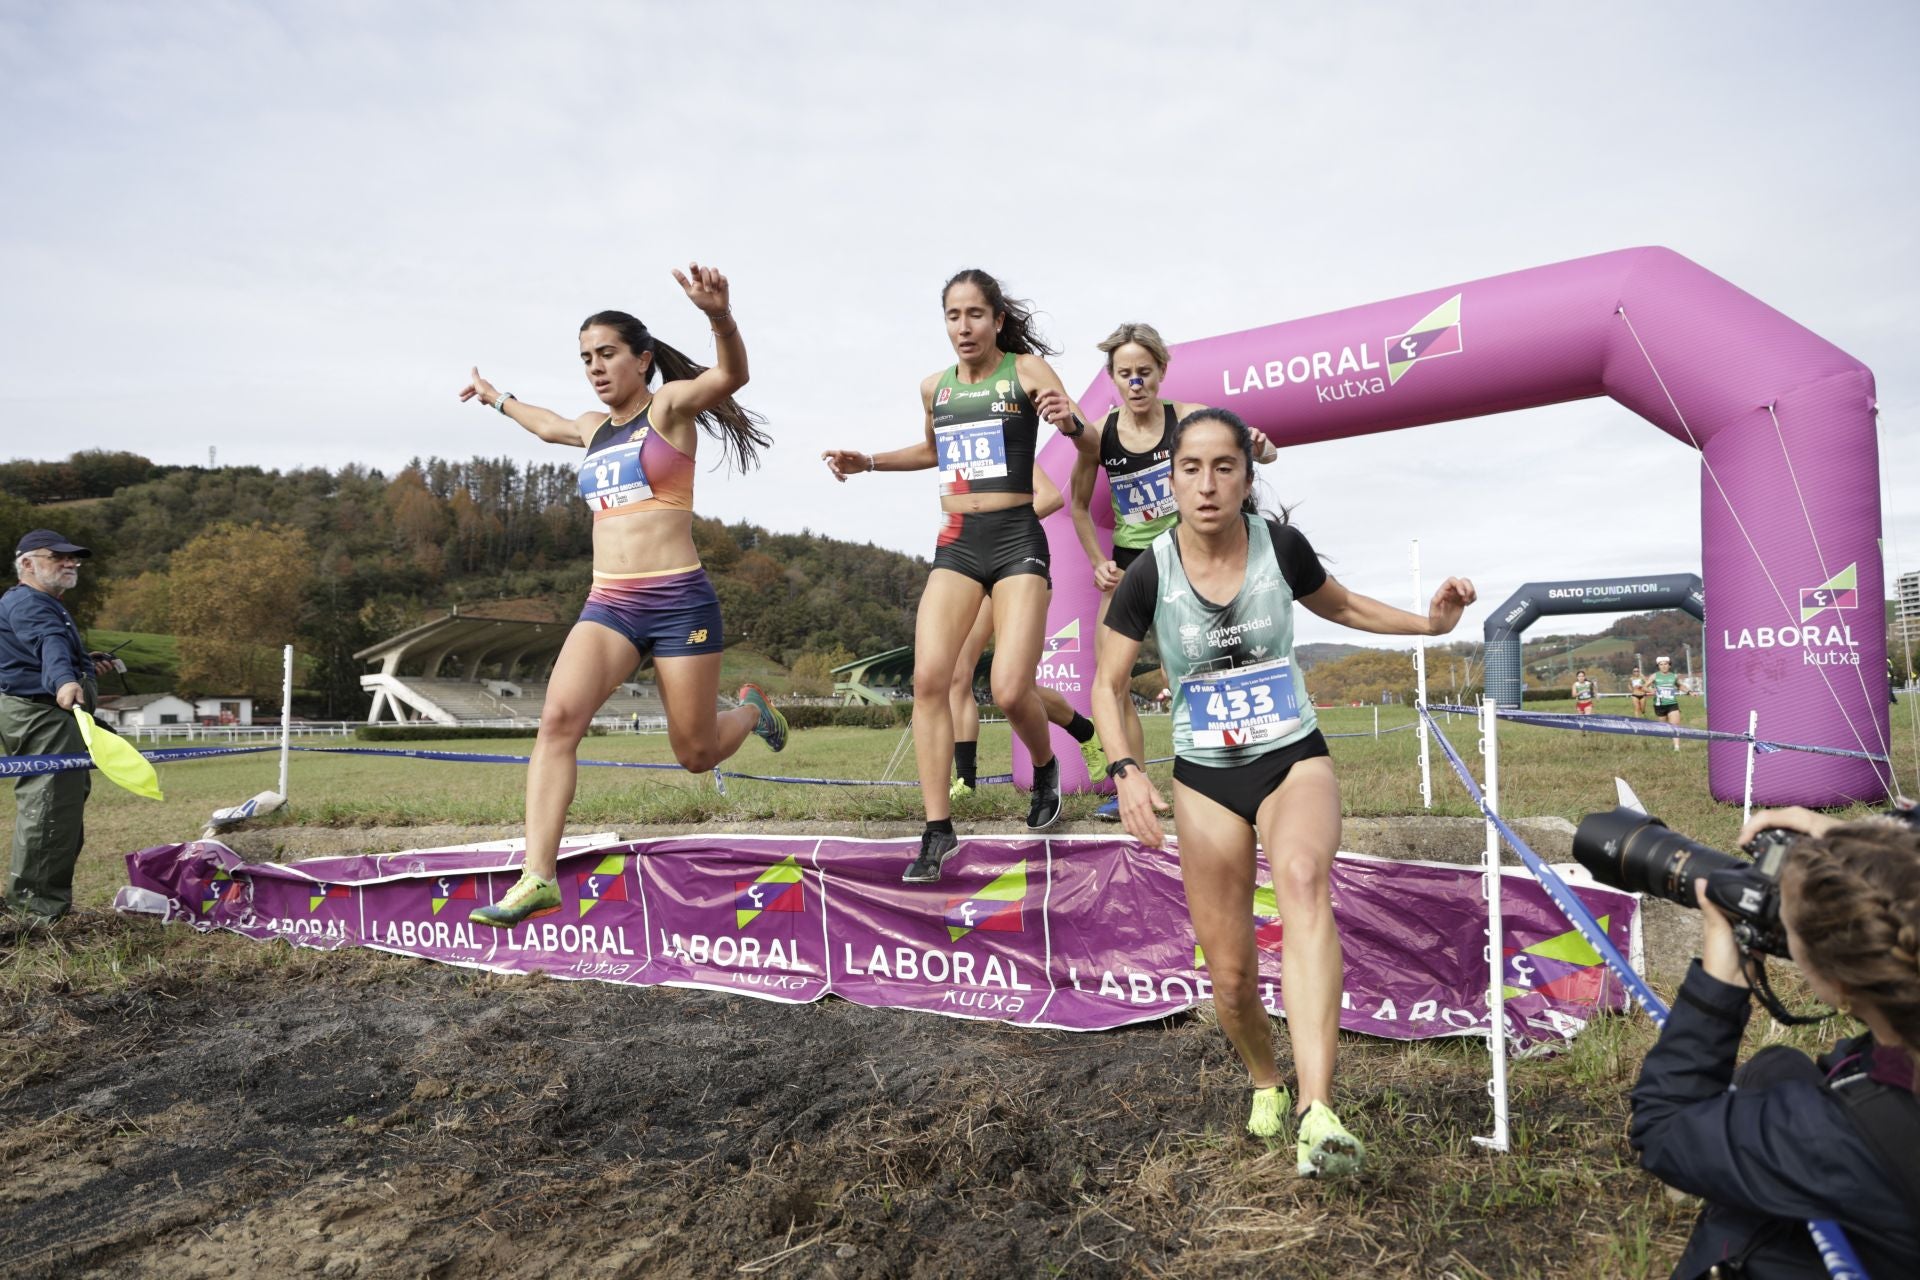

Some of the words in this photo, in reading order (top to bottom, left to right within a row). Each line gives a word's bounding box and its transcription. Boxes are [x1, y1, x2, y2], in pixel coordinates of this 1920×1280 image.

[1223, 343, 1380, 396] LABORAL
[1316, 377, 1385, 403] kutxa
[947, 437, 990, 462] 418
[595, 461, 621, 489] 27
[1129, 477, 1170, 506] 417
[1548, 588, 1583, 598] SALTO
[1586, 583, 1657, 597] FOUNDATION
[1206, 615, 1272, 640] universidad
[1724, 625, 1859, 650] LABORAL
[1803, 650, 1860, 665] kutxa
[1190, 685, 1200, 693] 69
[1206, 685, 1274, 721] 433
[1208, 720, 1238, 732] MIREN
[372, 921, 482, 949] LABORAL
[508, 923, 634, 955] LABORAL
[661, 928, 816, 973] LABORAL
[845, 943, 1032, 992] LABORAL
